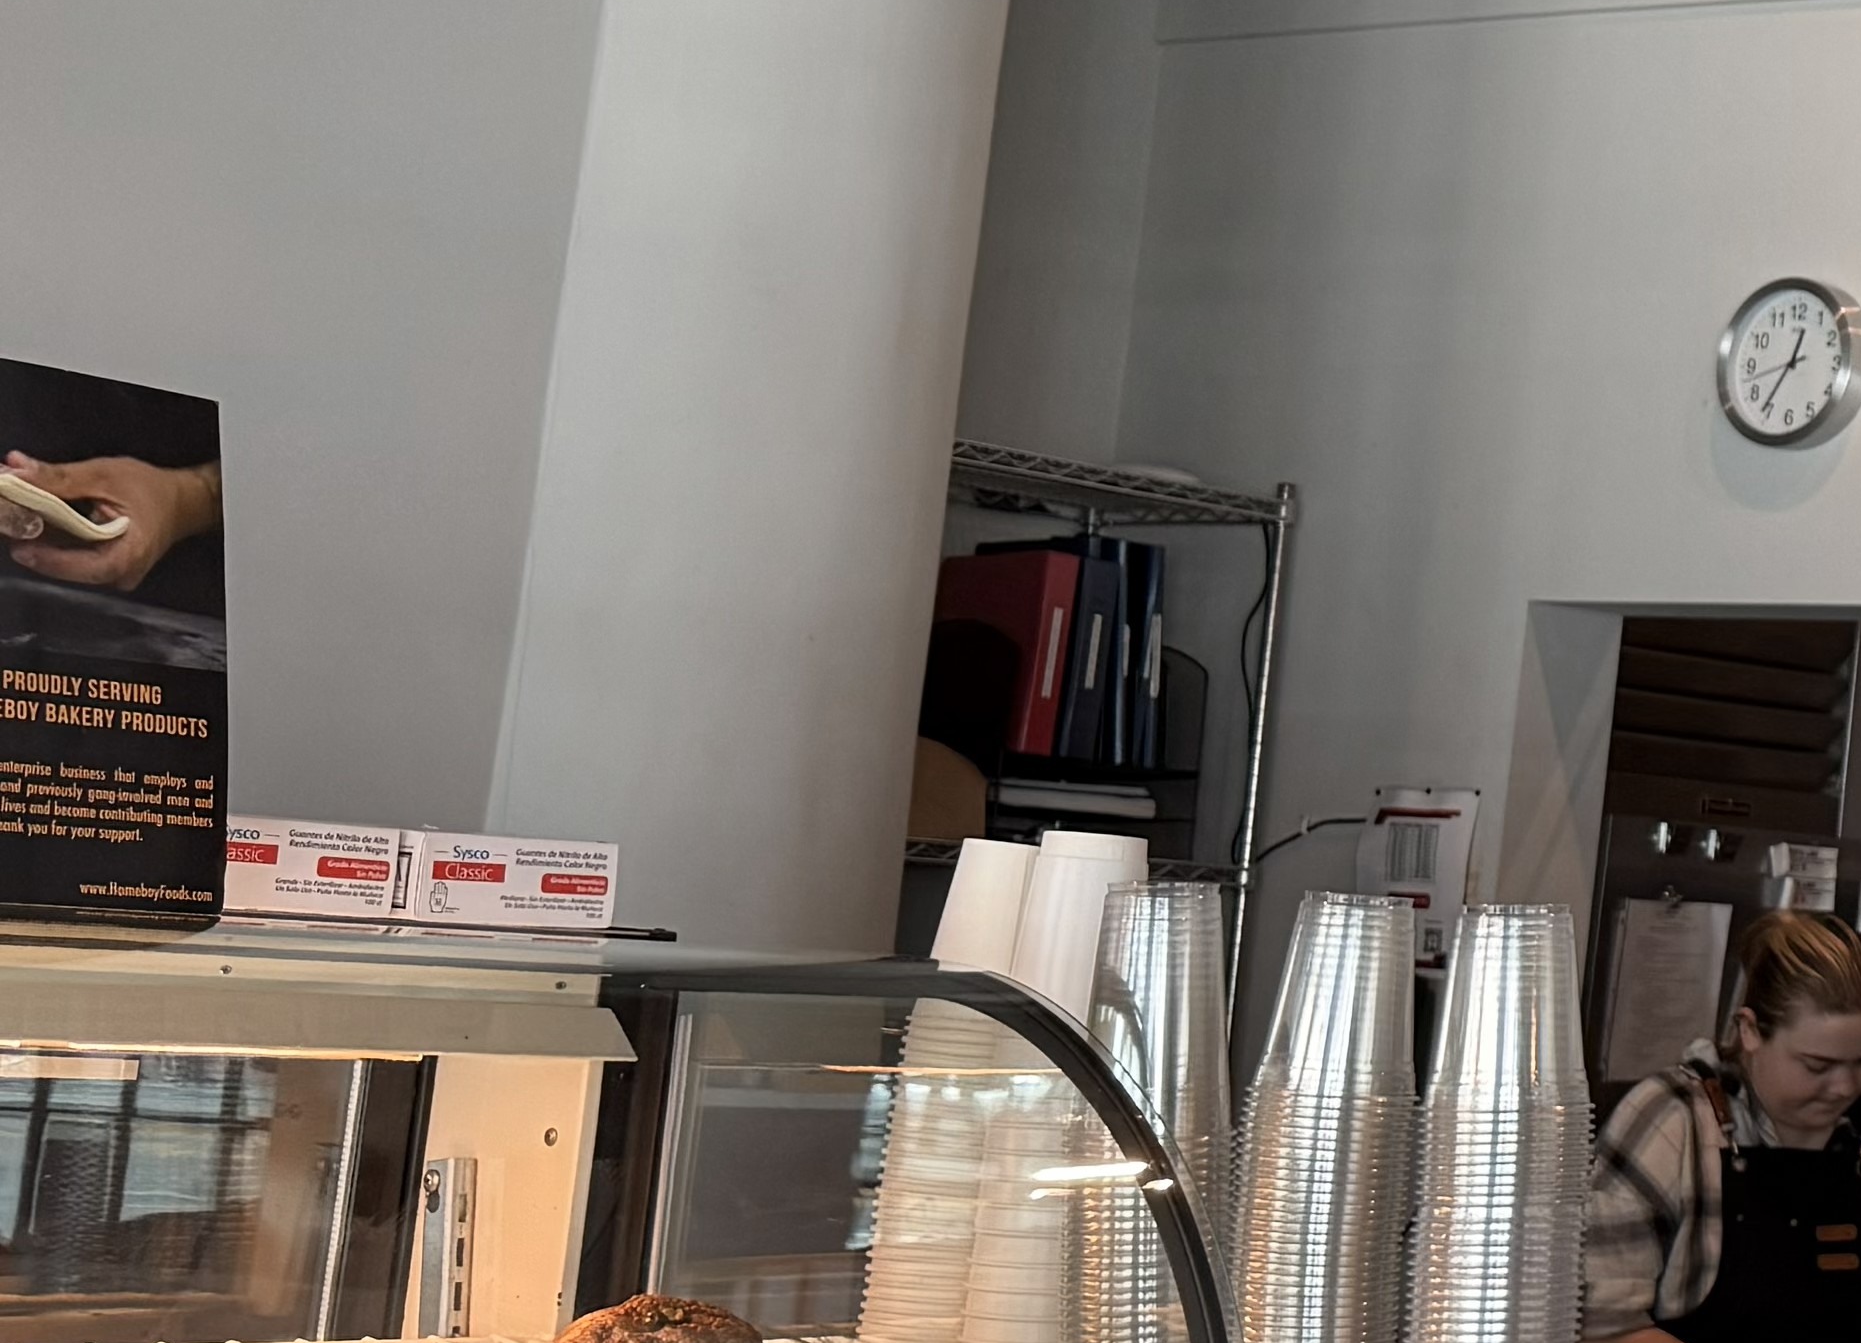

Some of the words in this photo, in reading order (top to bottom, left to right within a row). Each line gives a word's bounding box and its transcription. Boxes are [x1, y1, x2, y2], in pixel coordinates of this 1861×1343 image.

[2, 669, 83, 697] PROUDLY
[87, 678, 163, 706] SERVING
[45, 703, 115, 729] BAKERY
[120, 711, 209, 739] PRODUCTS
[60, 762, 107, 781] business
[113, 765, 136, 783] that
[227, 845, 265, 863] assic
[453, 845, 490, 861] Sysco
[445, 862, 494, 882] Classic
